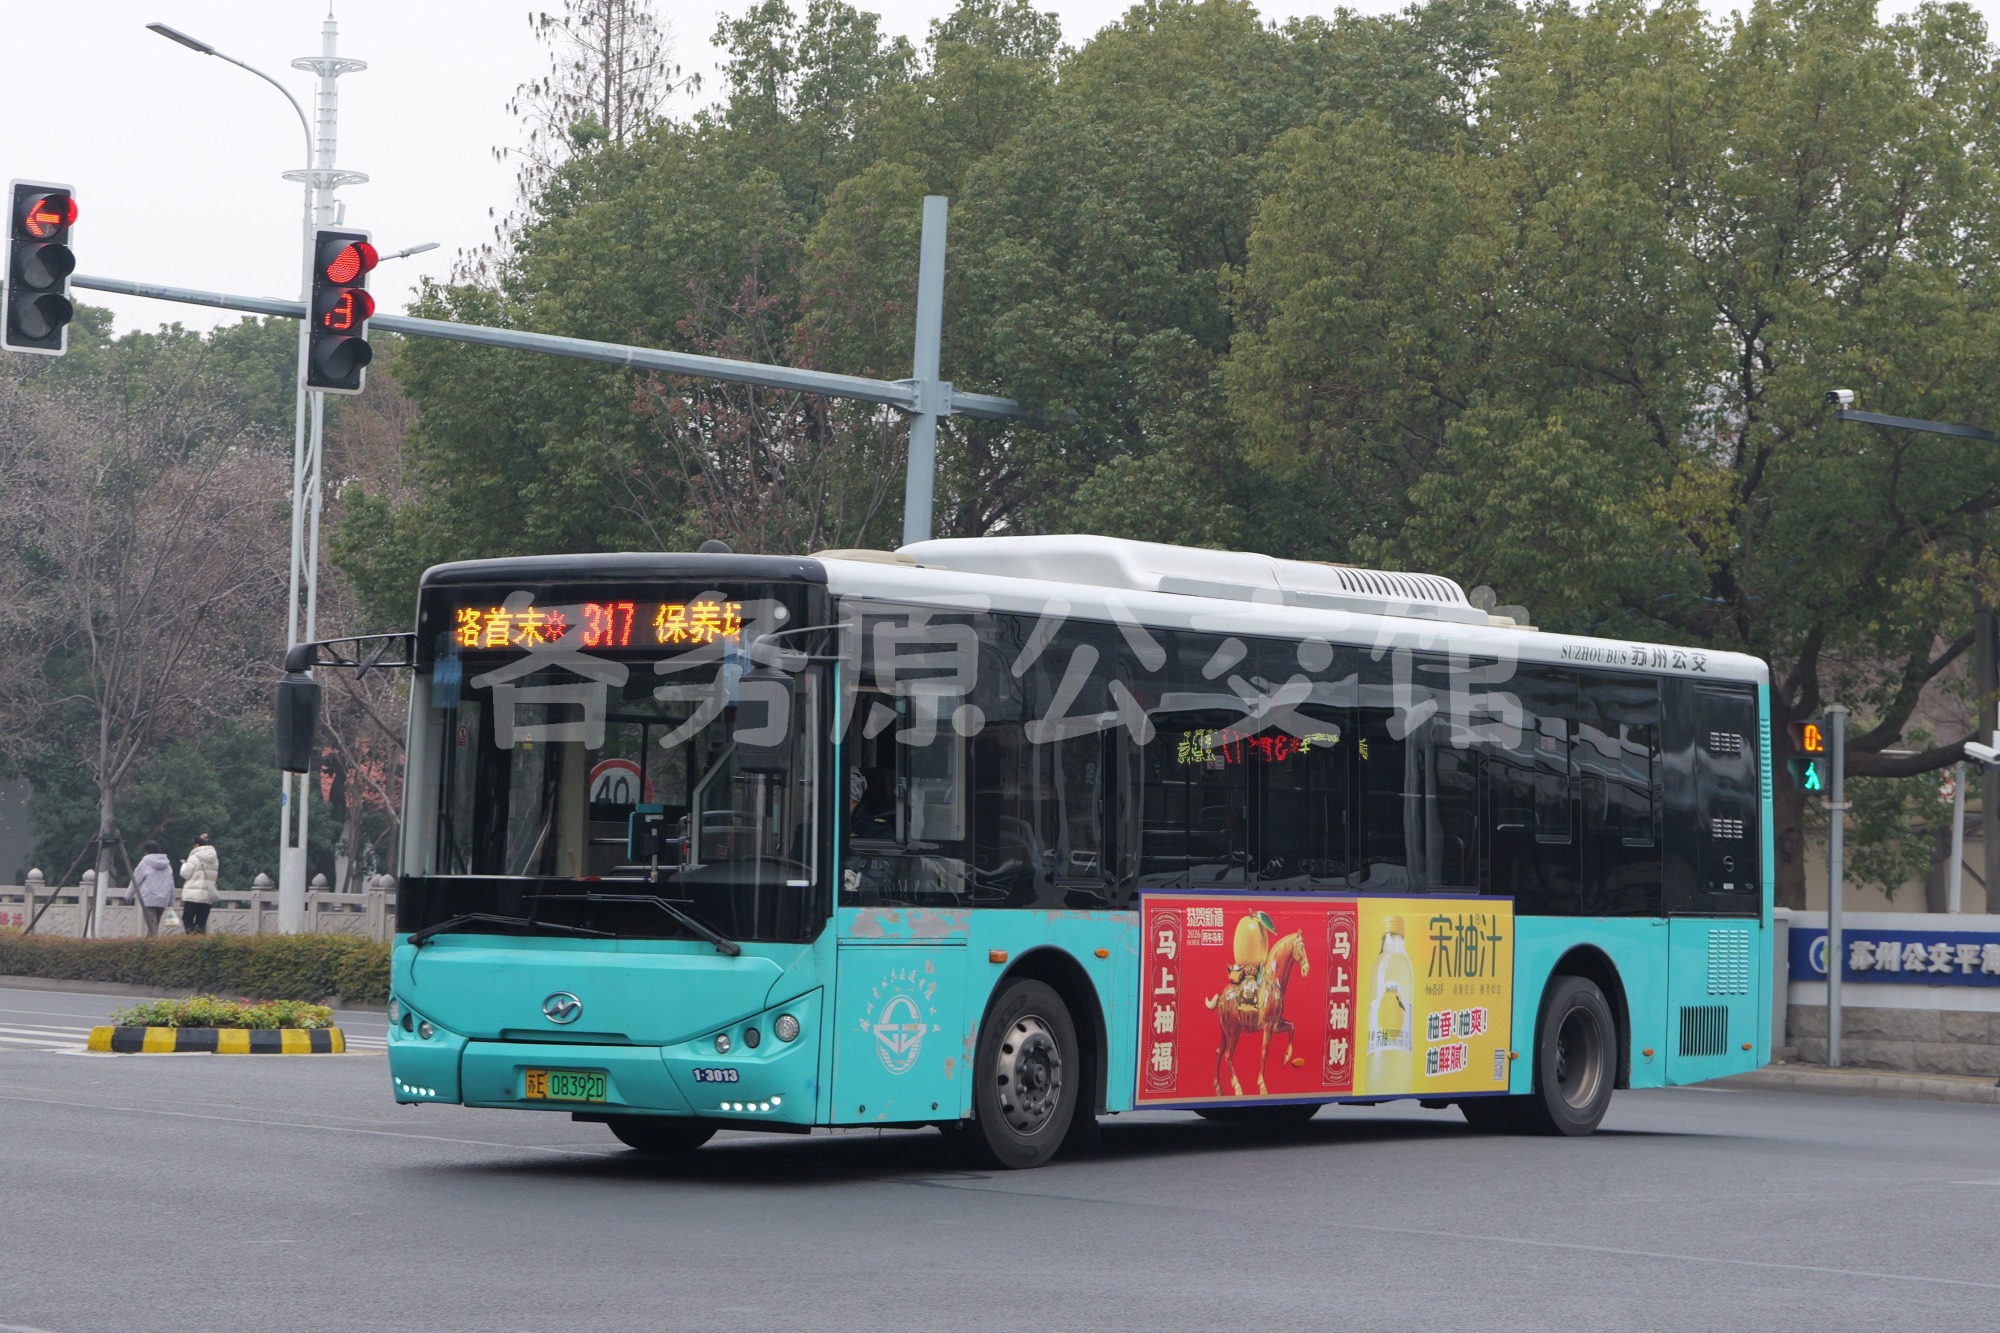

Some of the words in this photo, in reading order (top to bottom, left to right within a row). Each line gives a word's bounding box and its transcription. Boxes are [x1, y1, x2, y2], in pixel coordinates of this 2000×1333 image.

[584, 602, 634, 646] 317
[1561, 644, 1605, 663] SUZHOU
[1606, 649, 1627, 665] BUS
[1631, 645, 1707, 672] 苏州公交
[1187, 929, 1201, 939] 2026
[552, 1075, 604, 1098] 08392D
